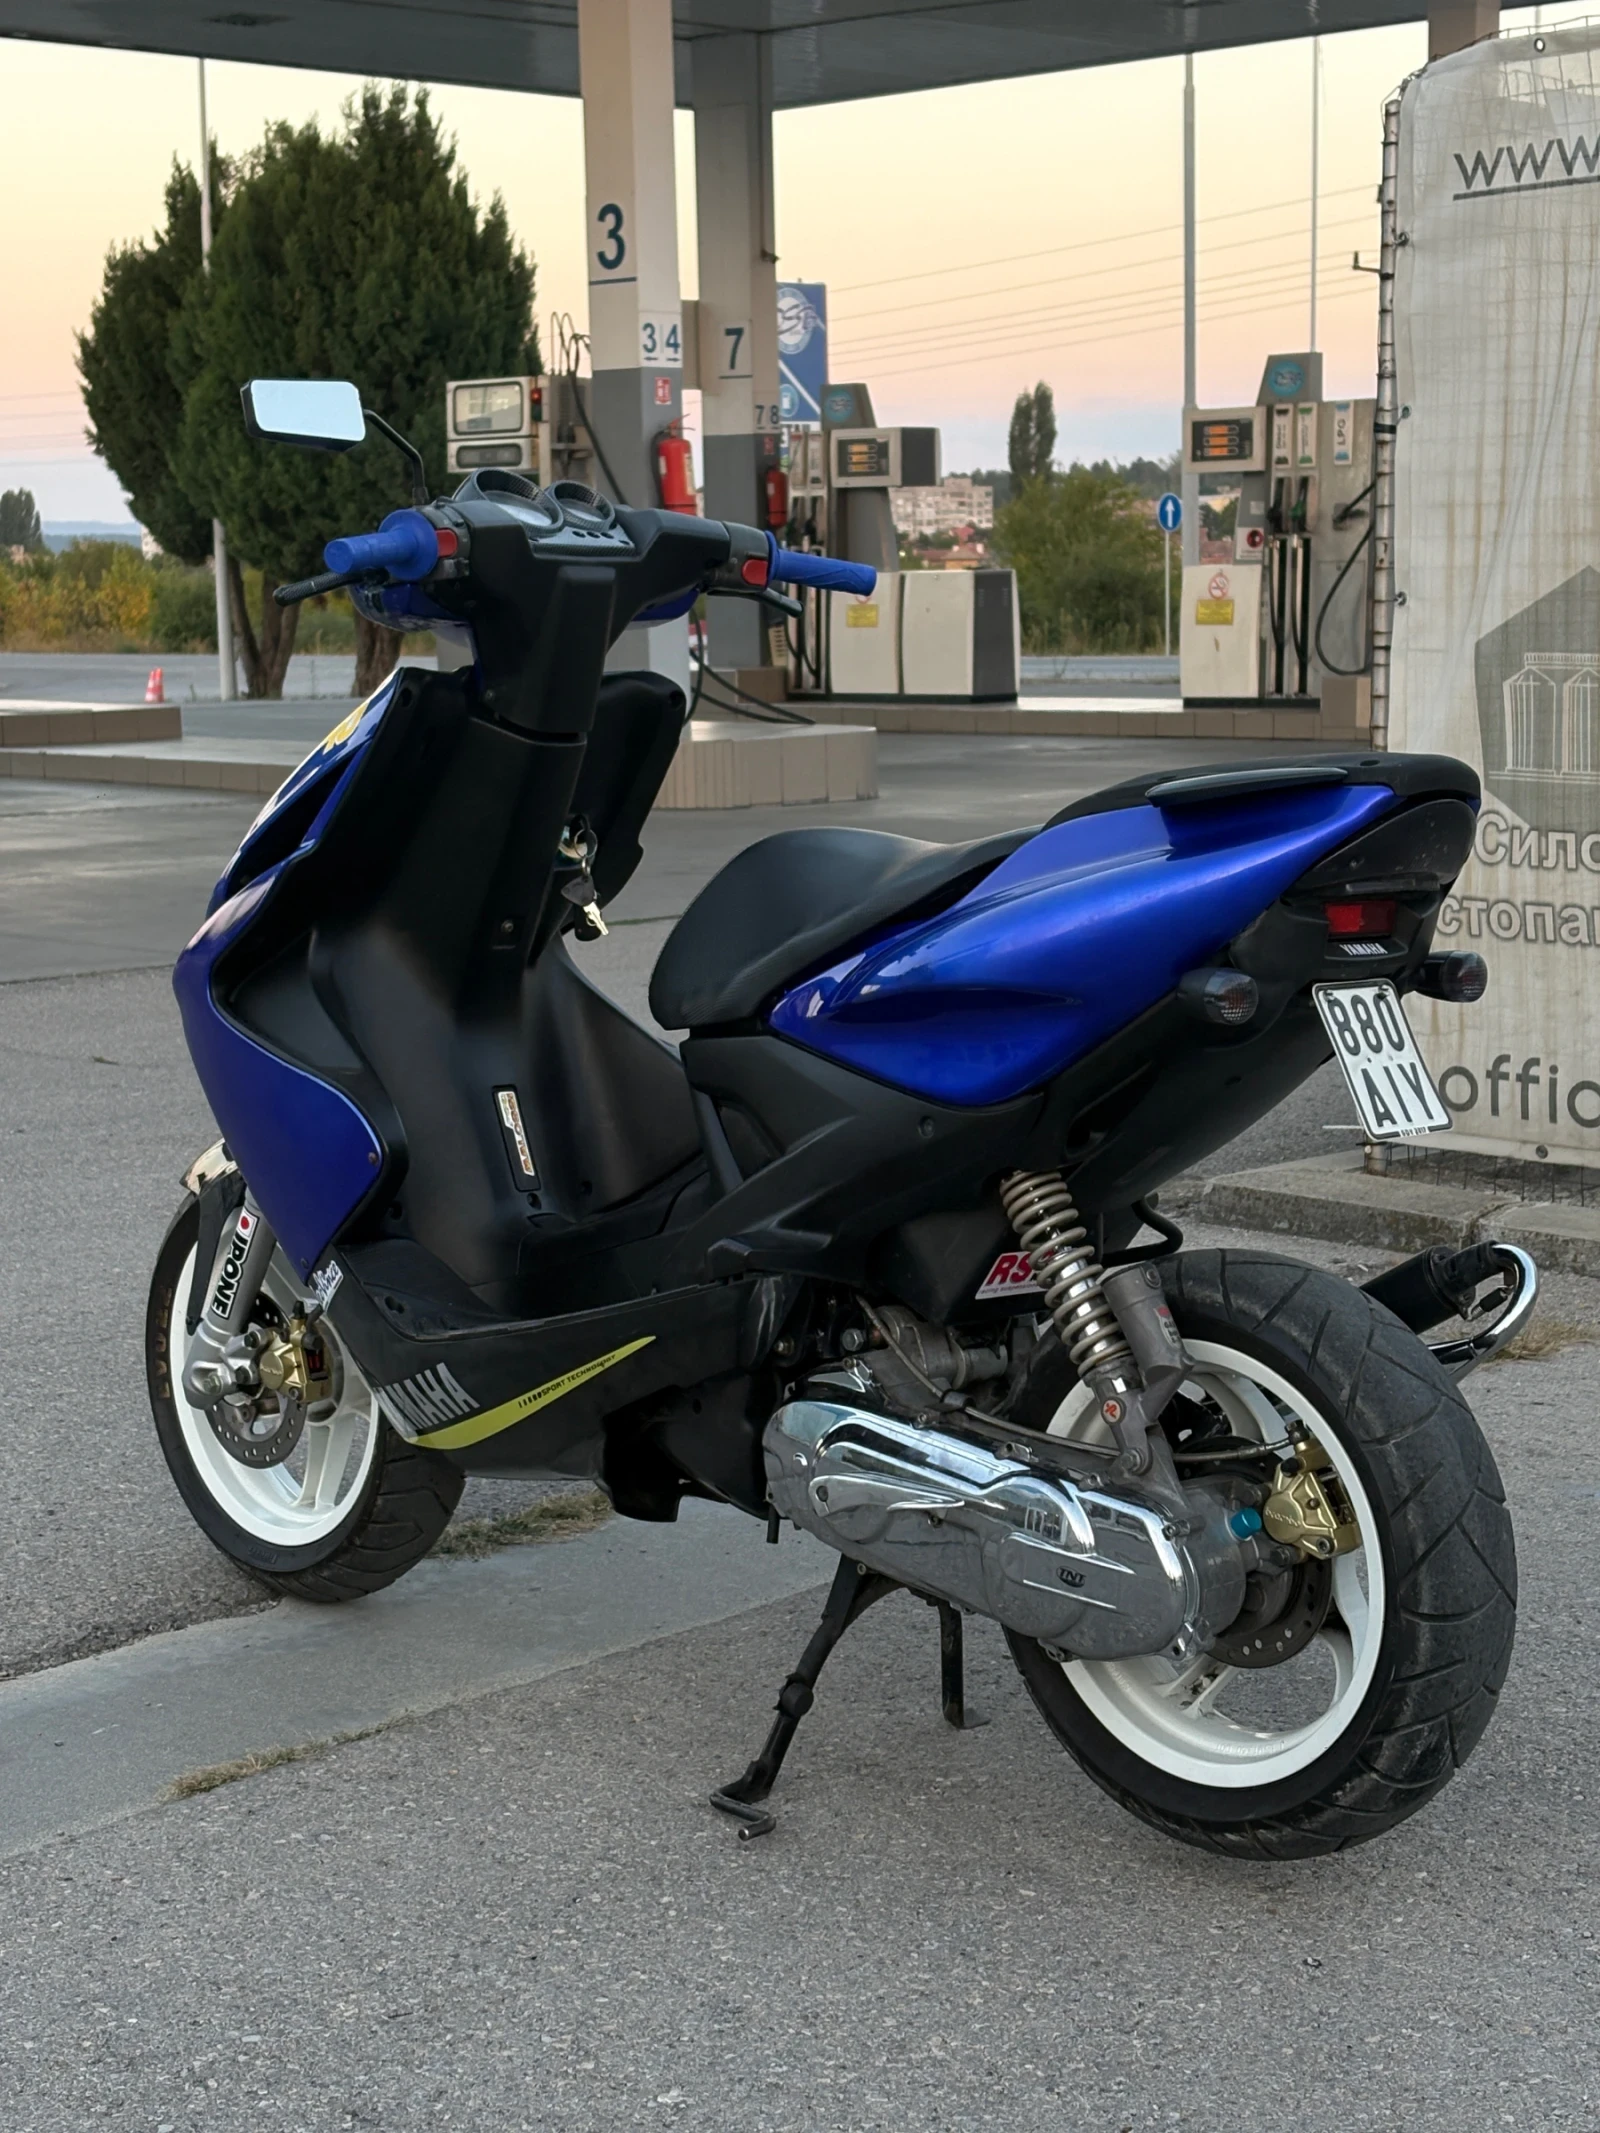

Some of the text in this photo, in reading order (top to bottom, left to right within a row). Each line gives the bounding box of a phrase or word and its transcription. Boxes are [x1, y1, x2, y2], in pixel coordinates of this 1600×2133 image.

[596, 203, 626, 270] 3
[643, 322, 681, 354] 3 4
[724, 327, 744, 370] 7
[755, 404, 780, 425] 7 8
[1336, 418, 1347, 446] LPG
[1436, 894, 1600, 946] стопа
[1339, 942, 1388, 956] YAMAHA
[1328, 994, 1405, 1056] 880
[1361, 1061, 1434, 1128] AIY
[211, 1230, 251, 1319] IPONE
[541, 1379, 566, 1397] SPORT
[1060, 1566, 1087, 1583] TNT
